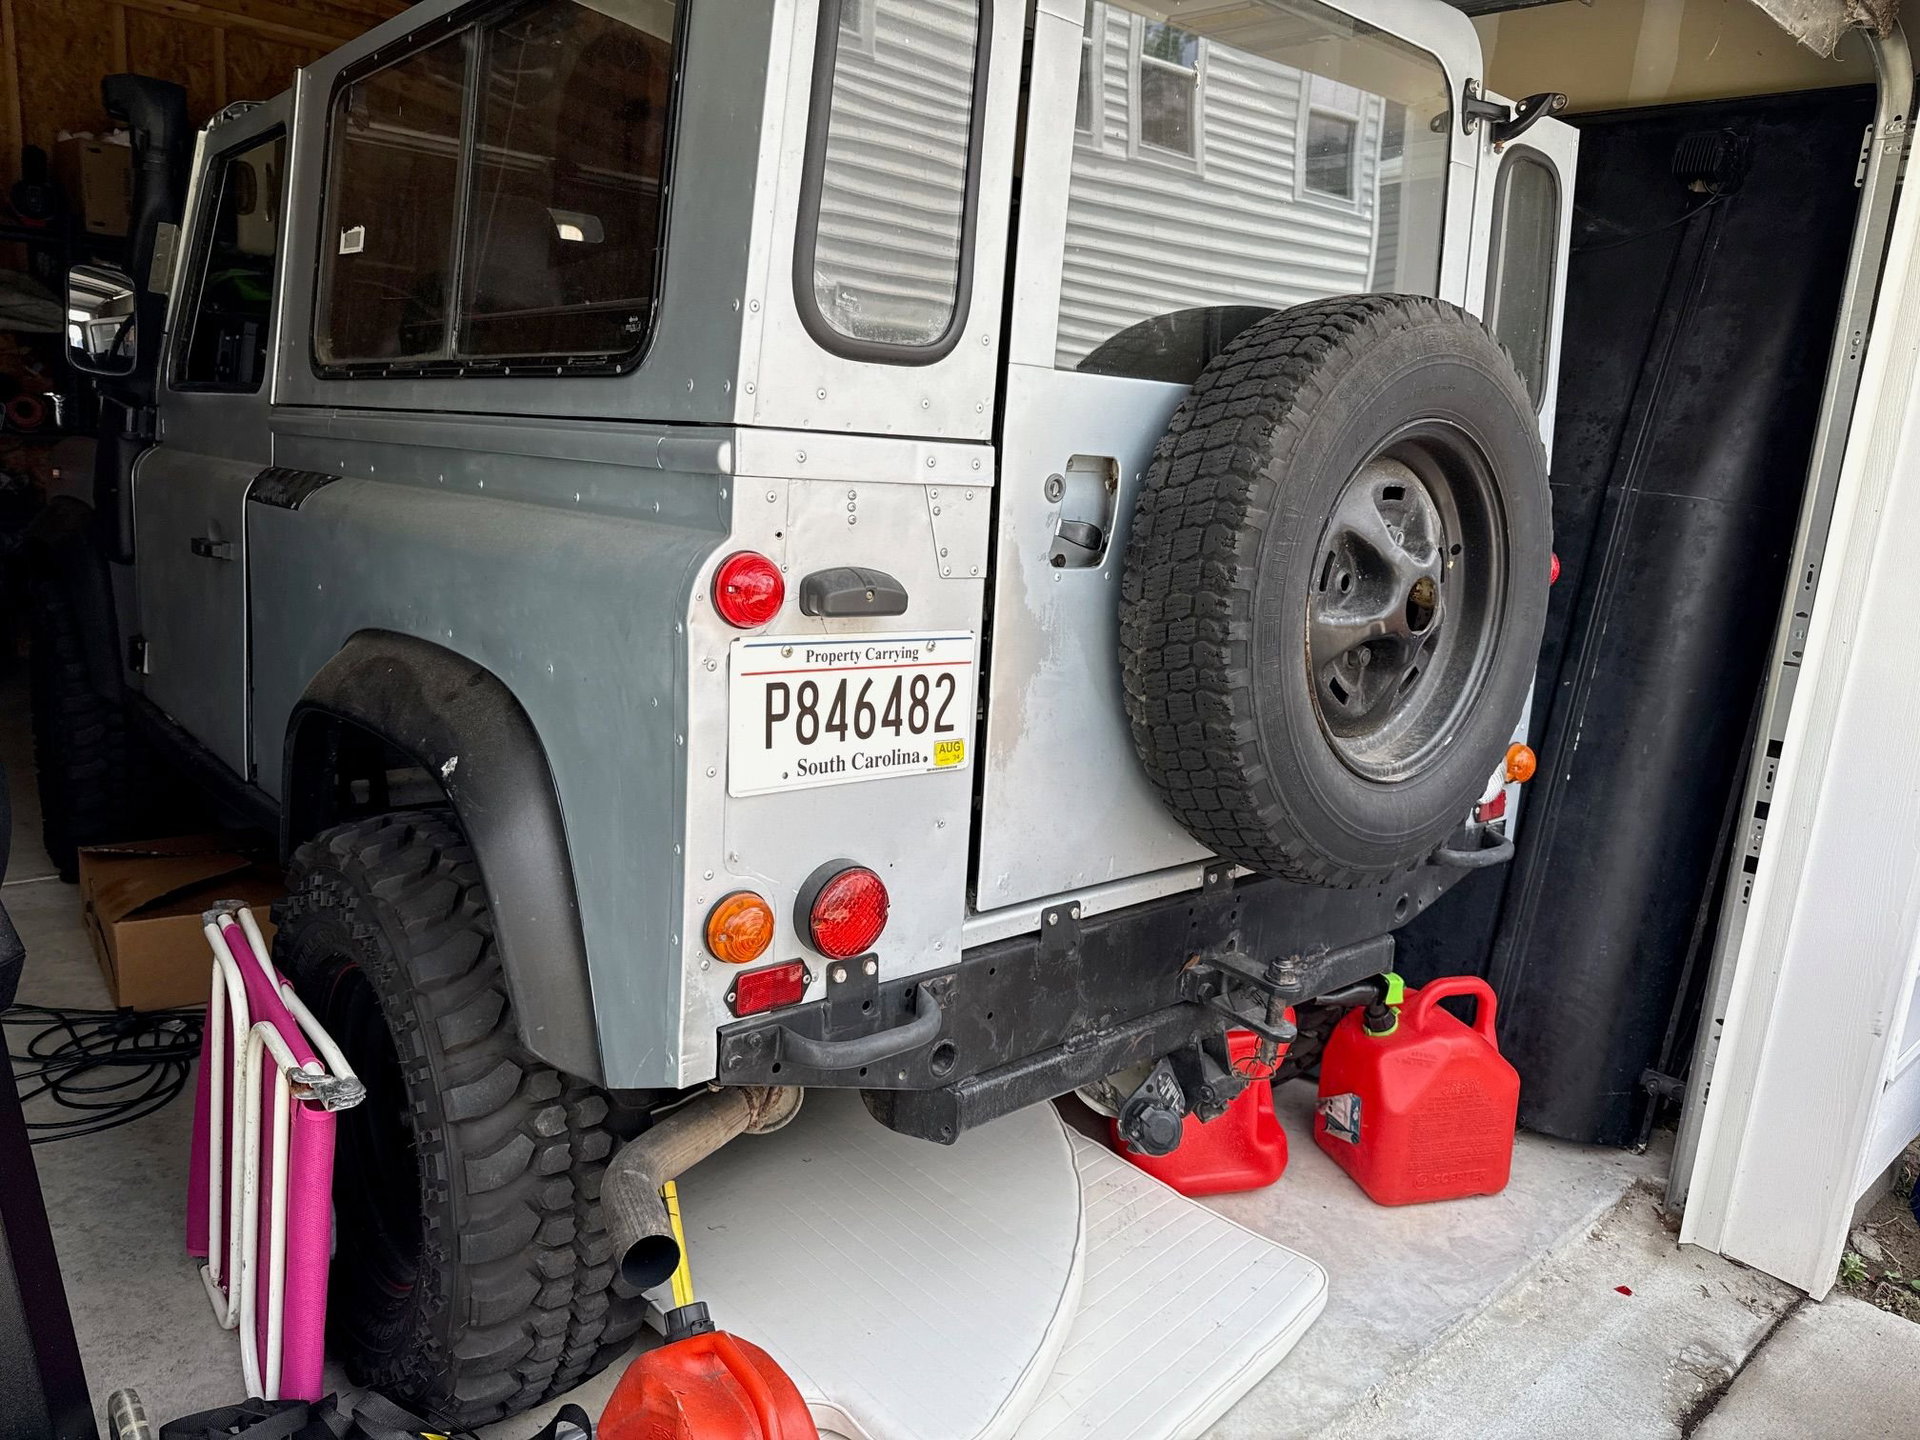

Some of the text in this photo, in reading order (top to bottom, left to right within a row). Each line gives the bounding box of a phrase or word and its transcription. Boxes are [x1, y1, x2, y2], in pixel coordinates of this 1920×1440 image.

[806, 646, 920, 666] Property Carrying
[765, 672, 956, 750] P846482
[938, 741, 961, 754] AUG
[796, 748, 921, 777] South Carolina
